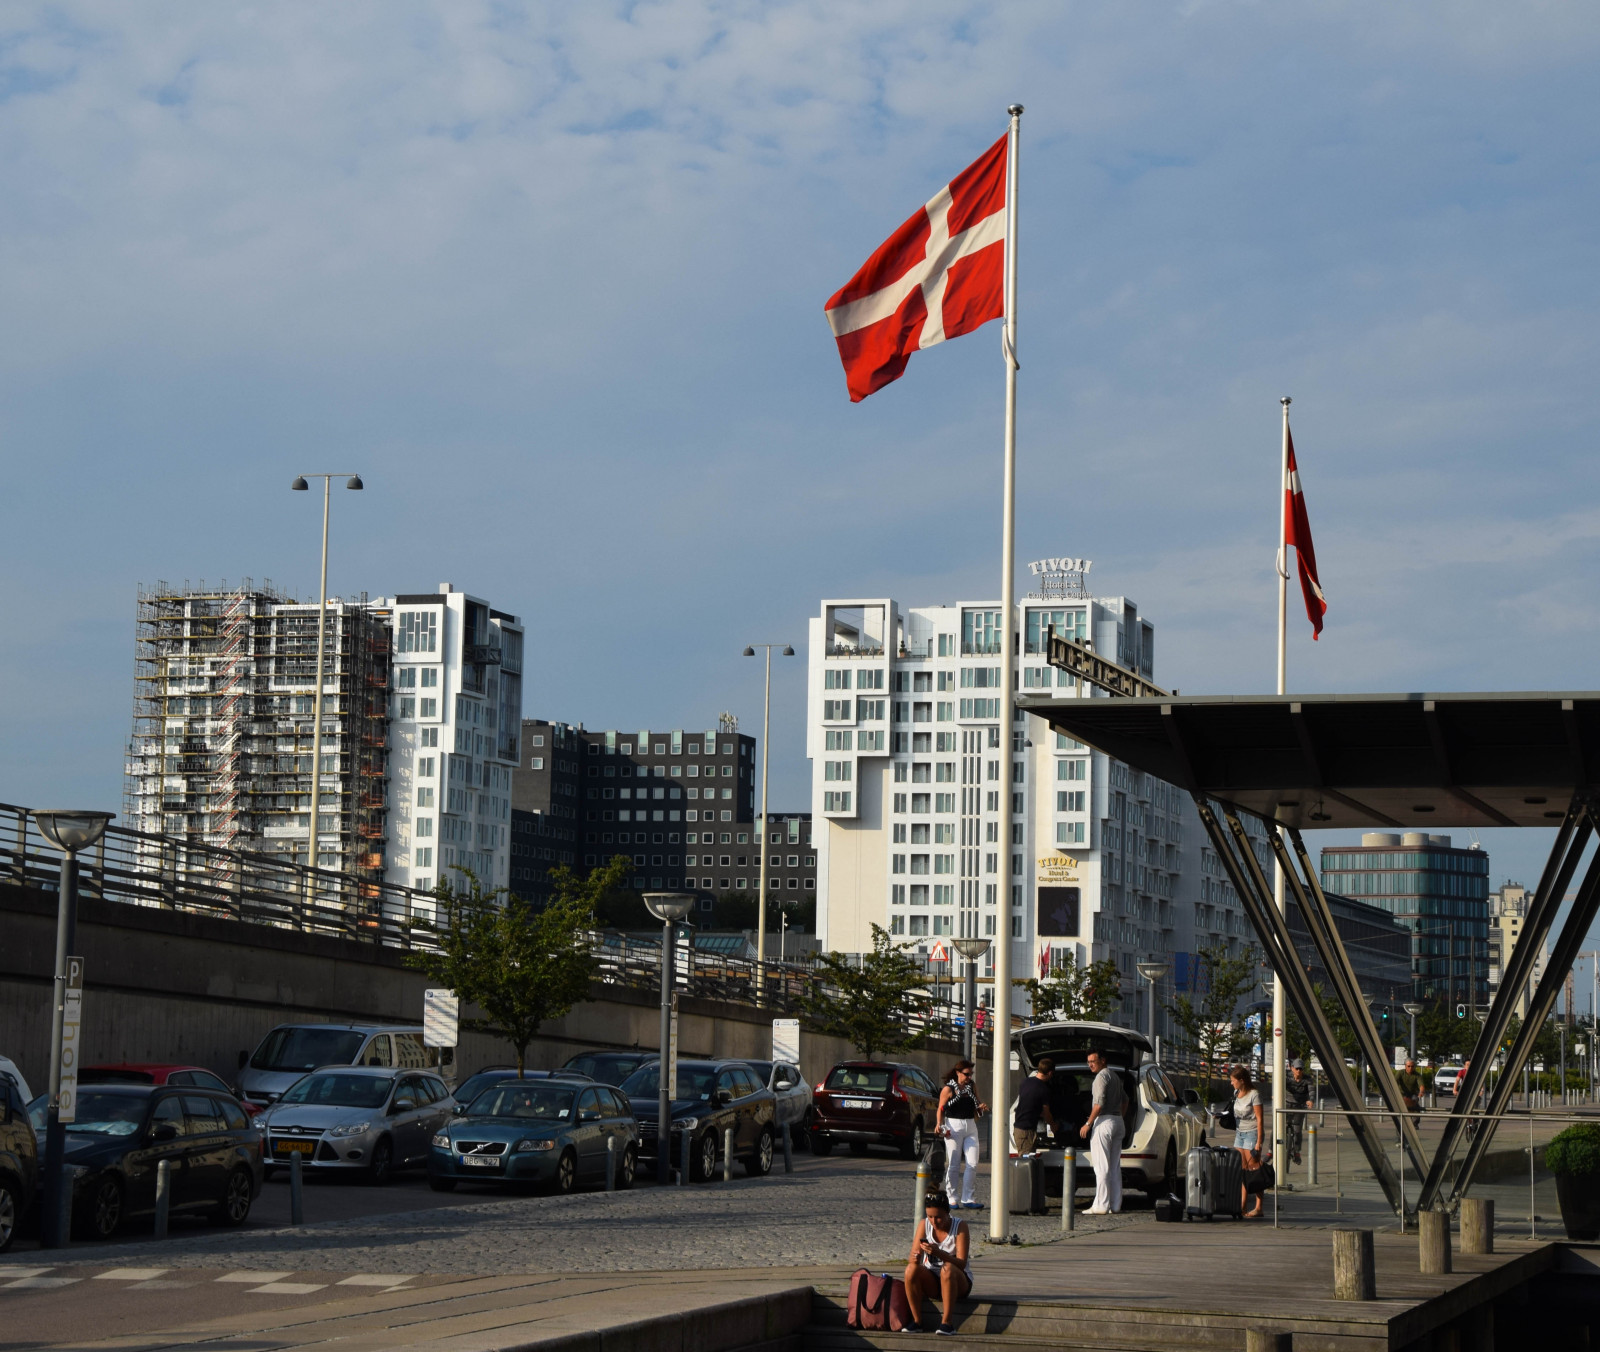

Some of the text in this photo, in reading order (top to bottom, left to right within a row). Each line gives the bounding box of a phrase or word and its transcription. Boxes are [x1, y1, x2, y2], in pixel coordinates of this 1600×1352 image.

[1028, 558, 1092, 576] TIVOLI
[1038, 857, 1079, 869] TIVOLI
[69, 961, 80, 987] P
[59, 1021, 80, 1122] hotel
